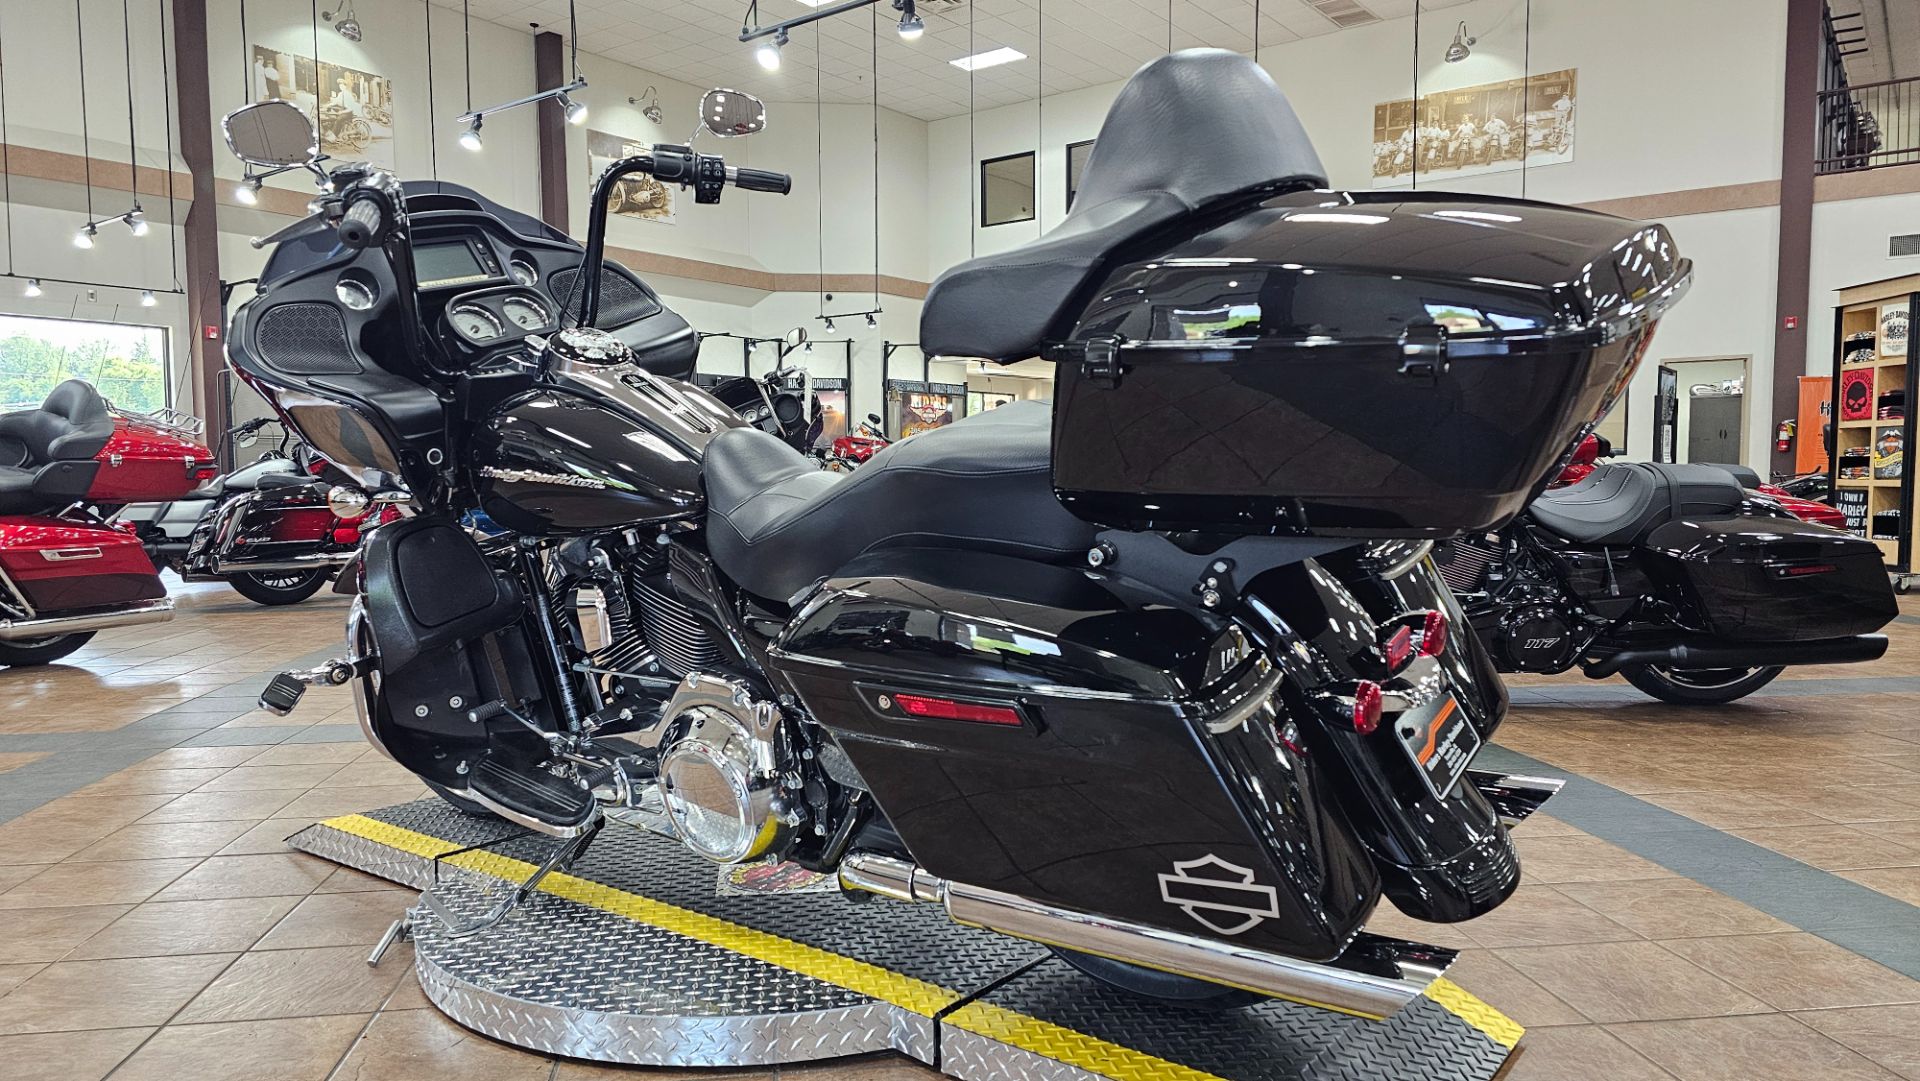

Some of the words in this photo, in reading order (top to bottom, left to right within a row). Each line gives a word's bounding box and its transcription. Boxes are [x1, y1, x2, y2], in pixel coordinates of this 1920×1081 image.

[910, 393, 948, 409] RIDERS
[1843, 492, 1859, 502] OWN
[1836, 502, 1867, 516] HARLEY
[1523, 636, 1561, 649] 117
